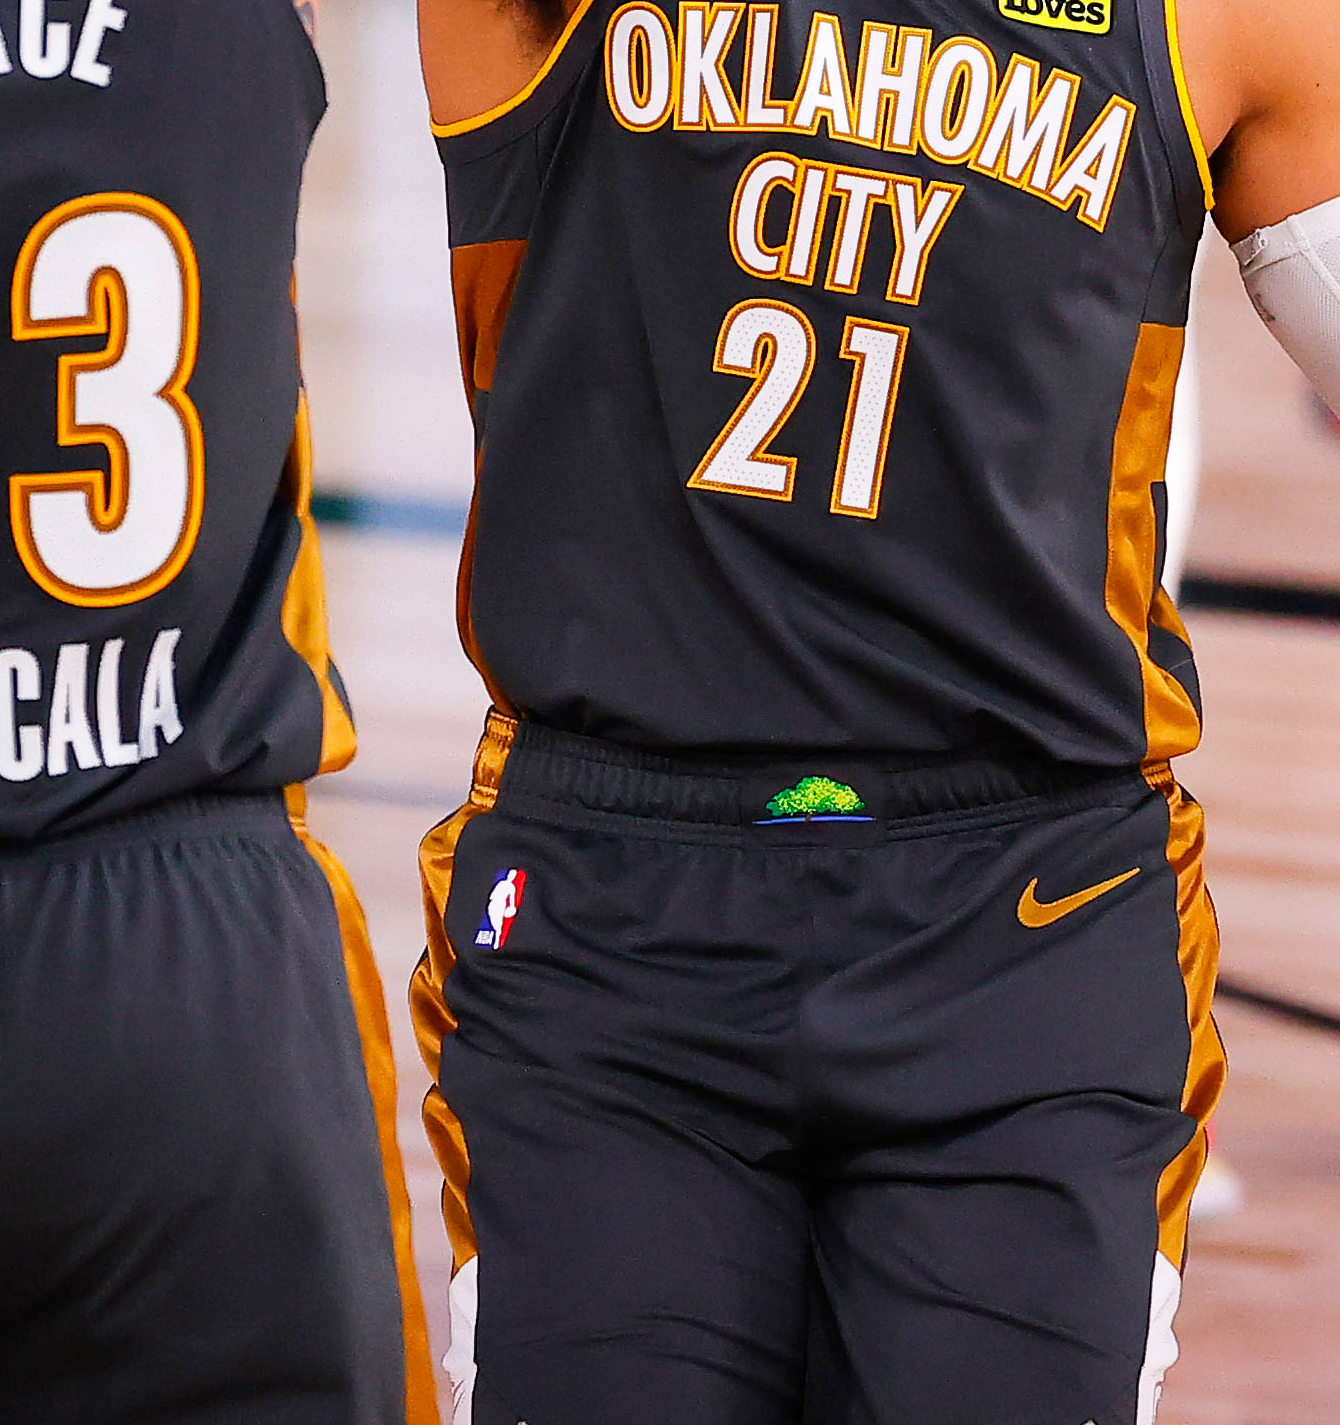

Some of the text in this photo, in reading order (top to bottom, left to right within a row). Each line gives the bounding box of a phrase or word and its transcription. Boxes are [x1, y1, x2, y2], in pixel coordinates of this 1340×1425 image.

[603, 1, 1138, 234] OKLAHOMA
[728, 151, 964, 306] CITY
[687, 298, 910, 520] 21
